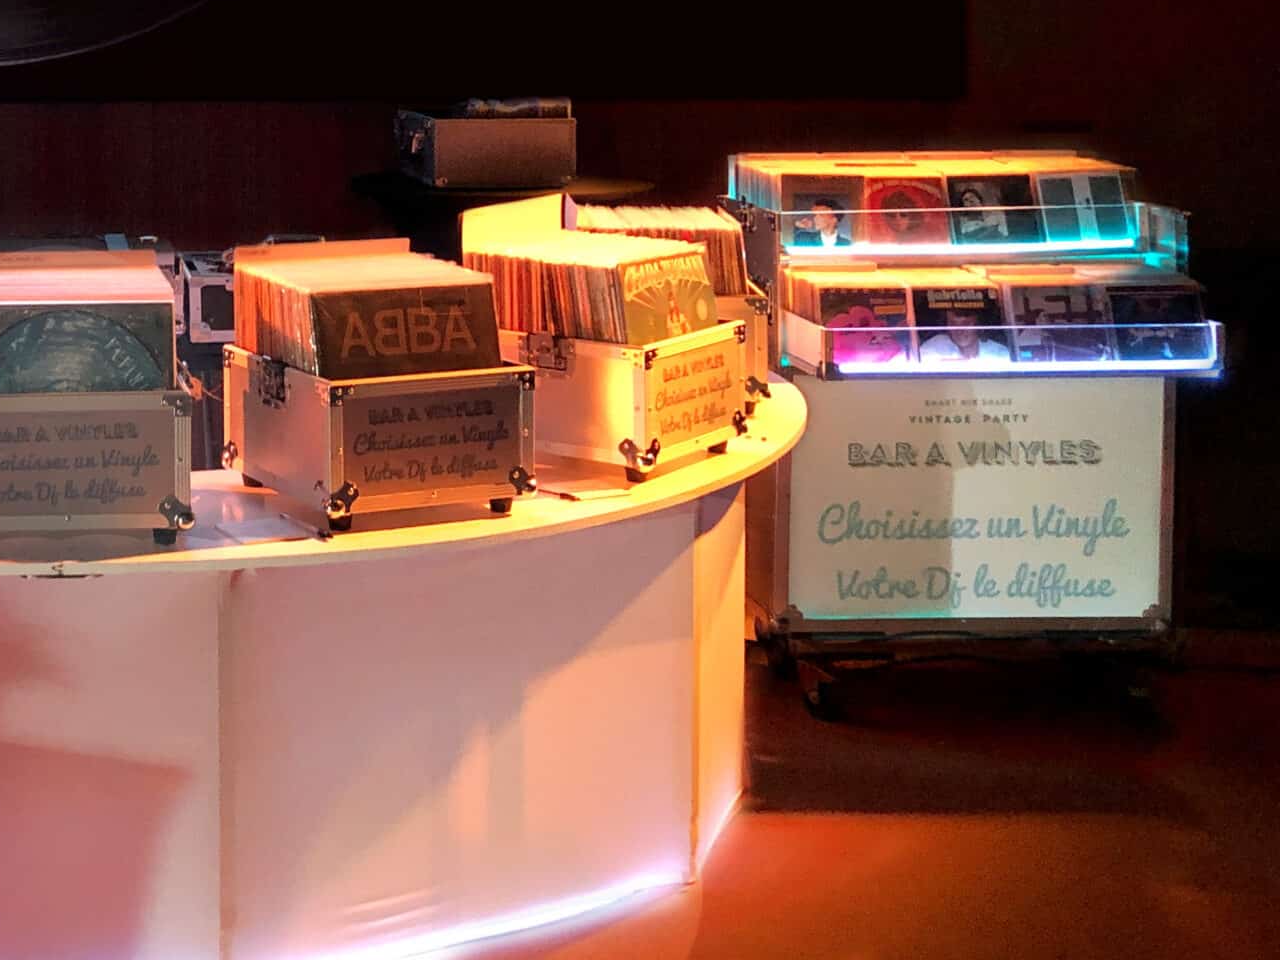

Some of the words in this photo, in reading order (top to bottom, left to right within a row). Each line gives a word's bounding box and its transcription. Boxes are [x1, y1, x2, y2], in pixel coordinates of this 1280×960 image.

[340, 304, 477, 360] ABBA
[983, 413, 1029, 424] PARTY
[848, 441, 918, 468] BAR
[924, 440, 953, 467] A
[957, 439, 1103, 465] VINYLES
[818, 500, 981, 546] Choisissez
[986, 515, 1028, 540] un
[1031, 498, 1131, 558] Vinyle
[836, 567, 920, 602] Votre
[921, 565, 966, 609] Dj
[972, 563, 1001, 600] le
[1006, 562, 1117, 609] diffuse
